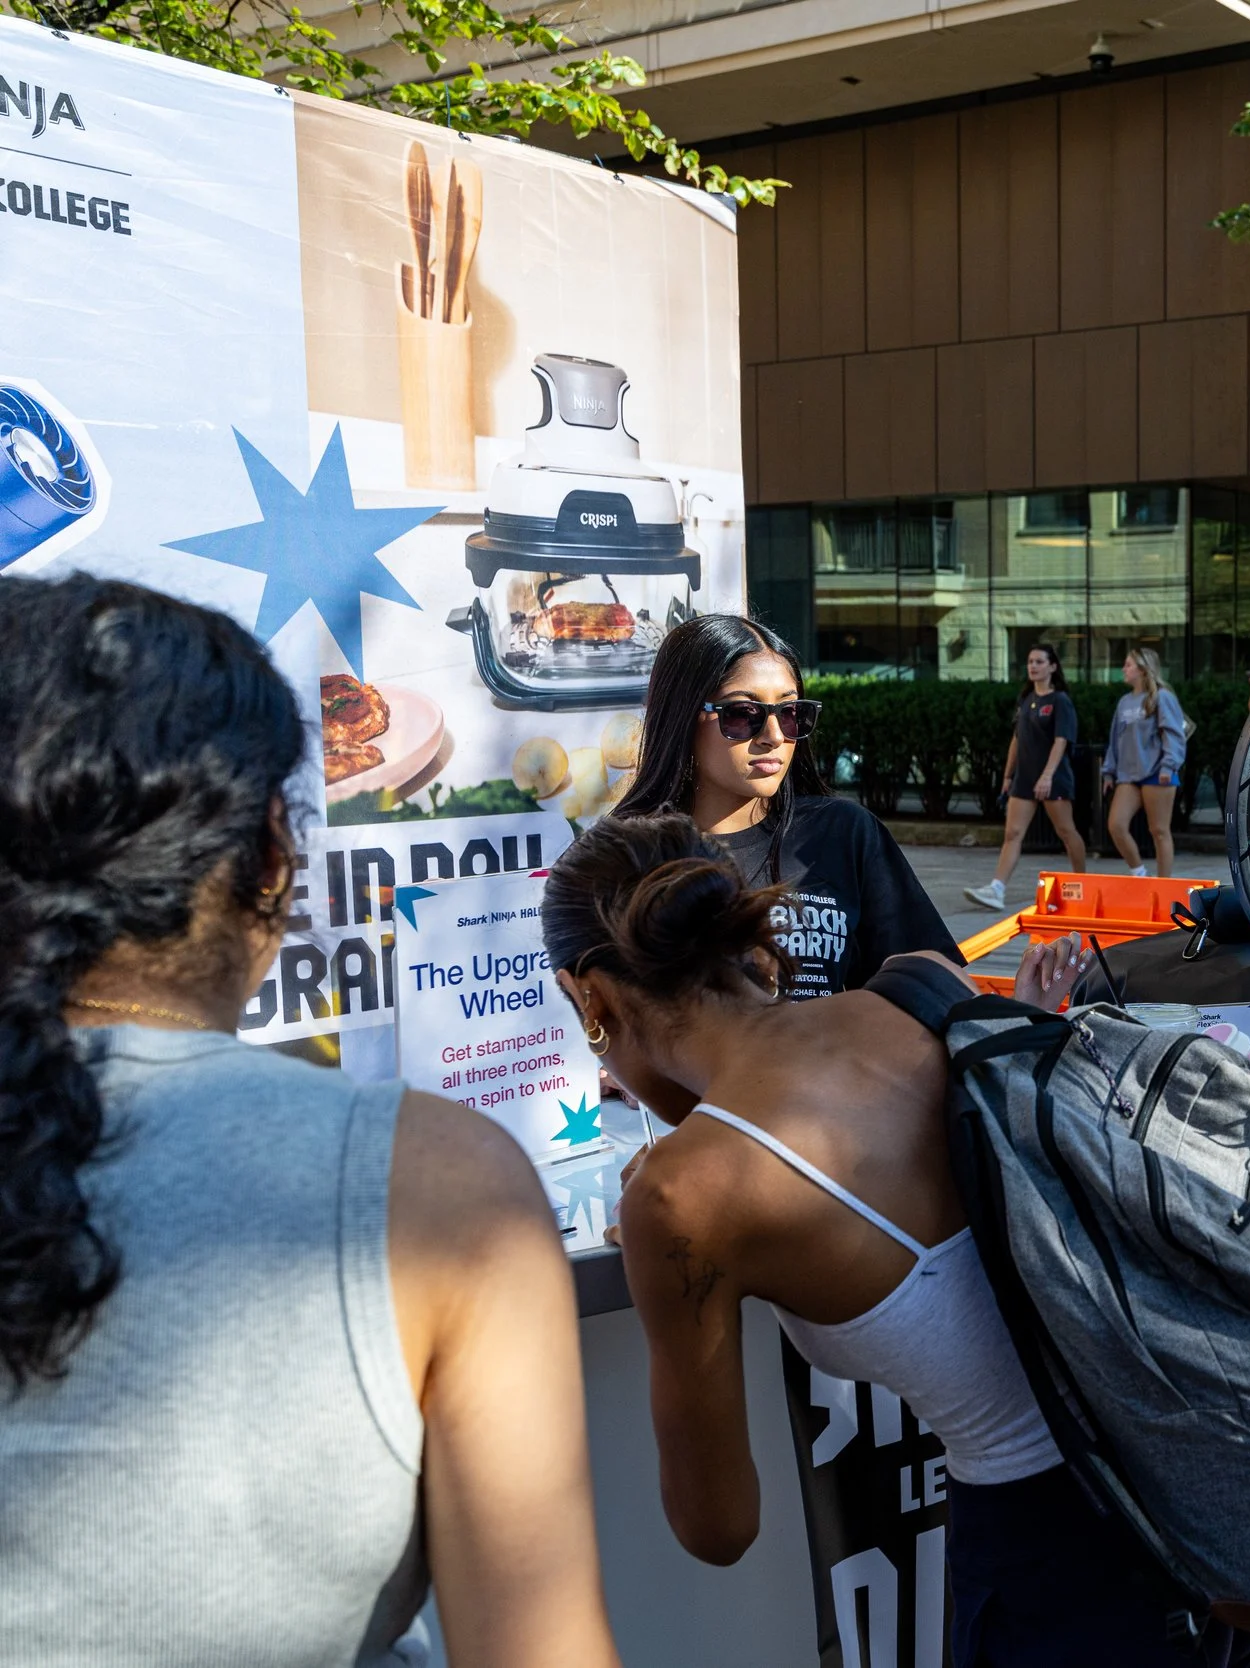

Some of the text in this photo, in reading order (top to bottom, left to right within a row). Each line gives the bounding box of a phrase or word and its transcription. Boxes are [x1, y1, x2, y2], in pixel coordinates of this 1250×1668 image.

[0, 178, 132, 236] OLLEGE
[573, 395, 606, 416] NINJA
[810, 894, 837, 906] COLLEGE
[457, 914, 488, 928] Shark
[491, 911, 517, 924] NINJA
[770, 905, 847, 936] BLOCK
[773, 931, 846, 963] PARTY
[409, 963, 464, 992] The
[459, 980, 544, 1019] Wheel
[442, 1026, 564, 1064] Get stamped in
[442, 1052, 565, 1090] all three rooms,
[481, 1086, 515, 1108] spin
[519, 1080, 535, 1097] to
[539, 1074, 570, 1094] win.
